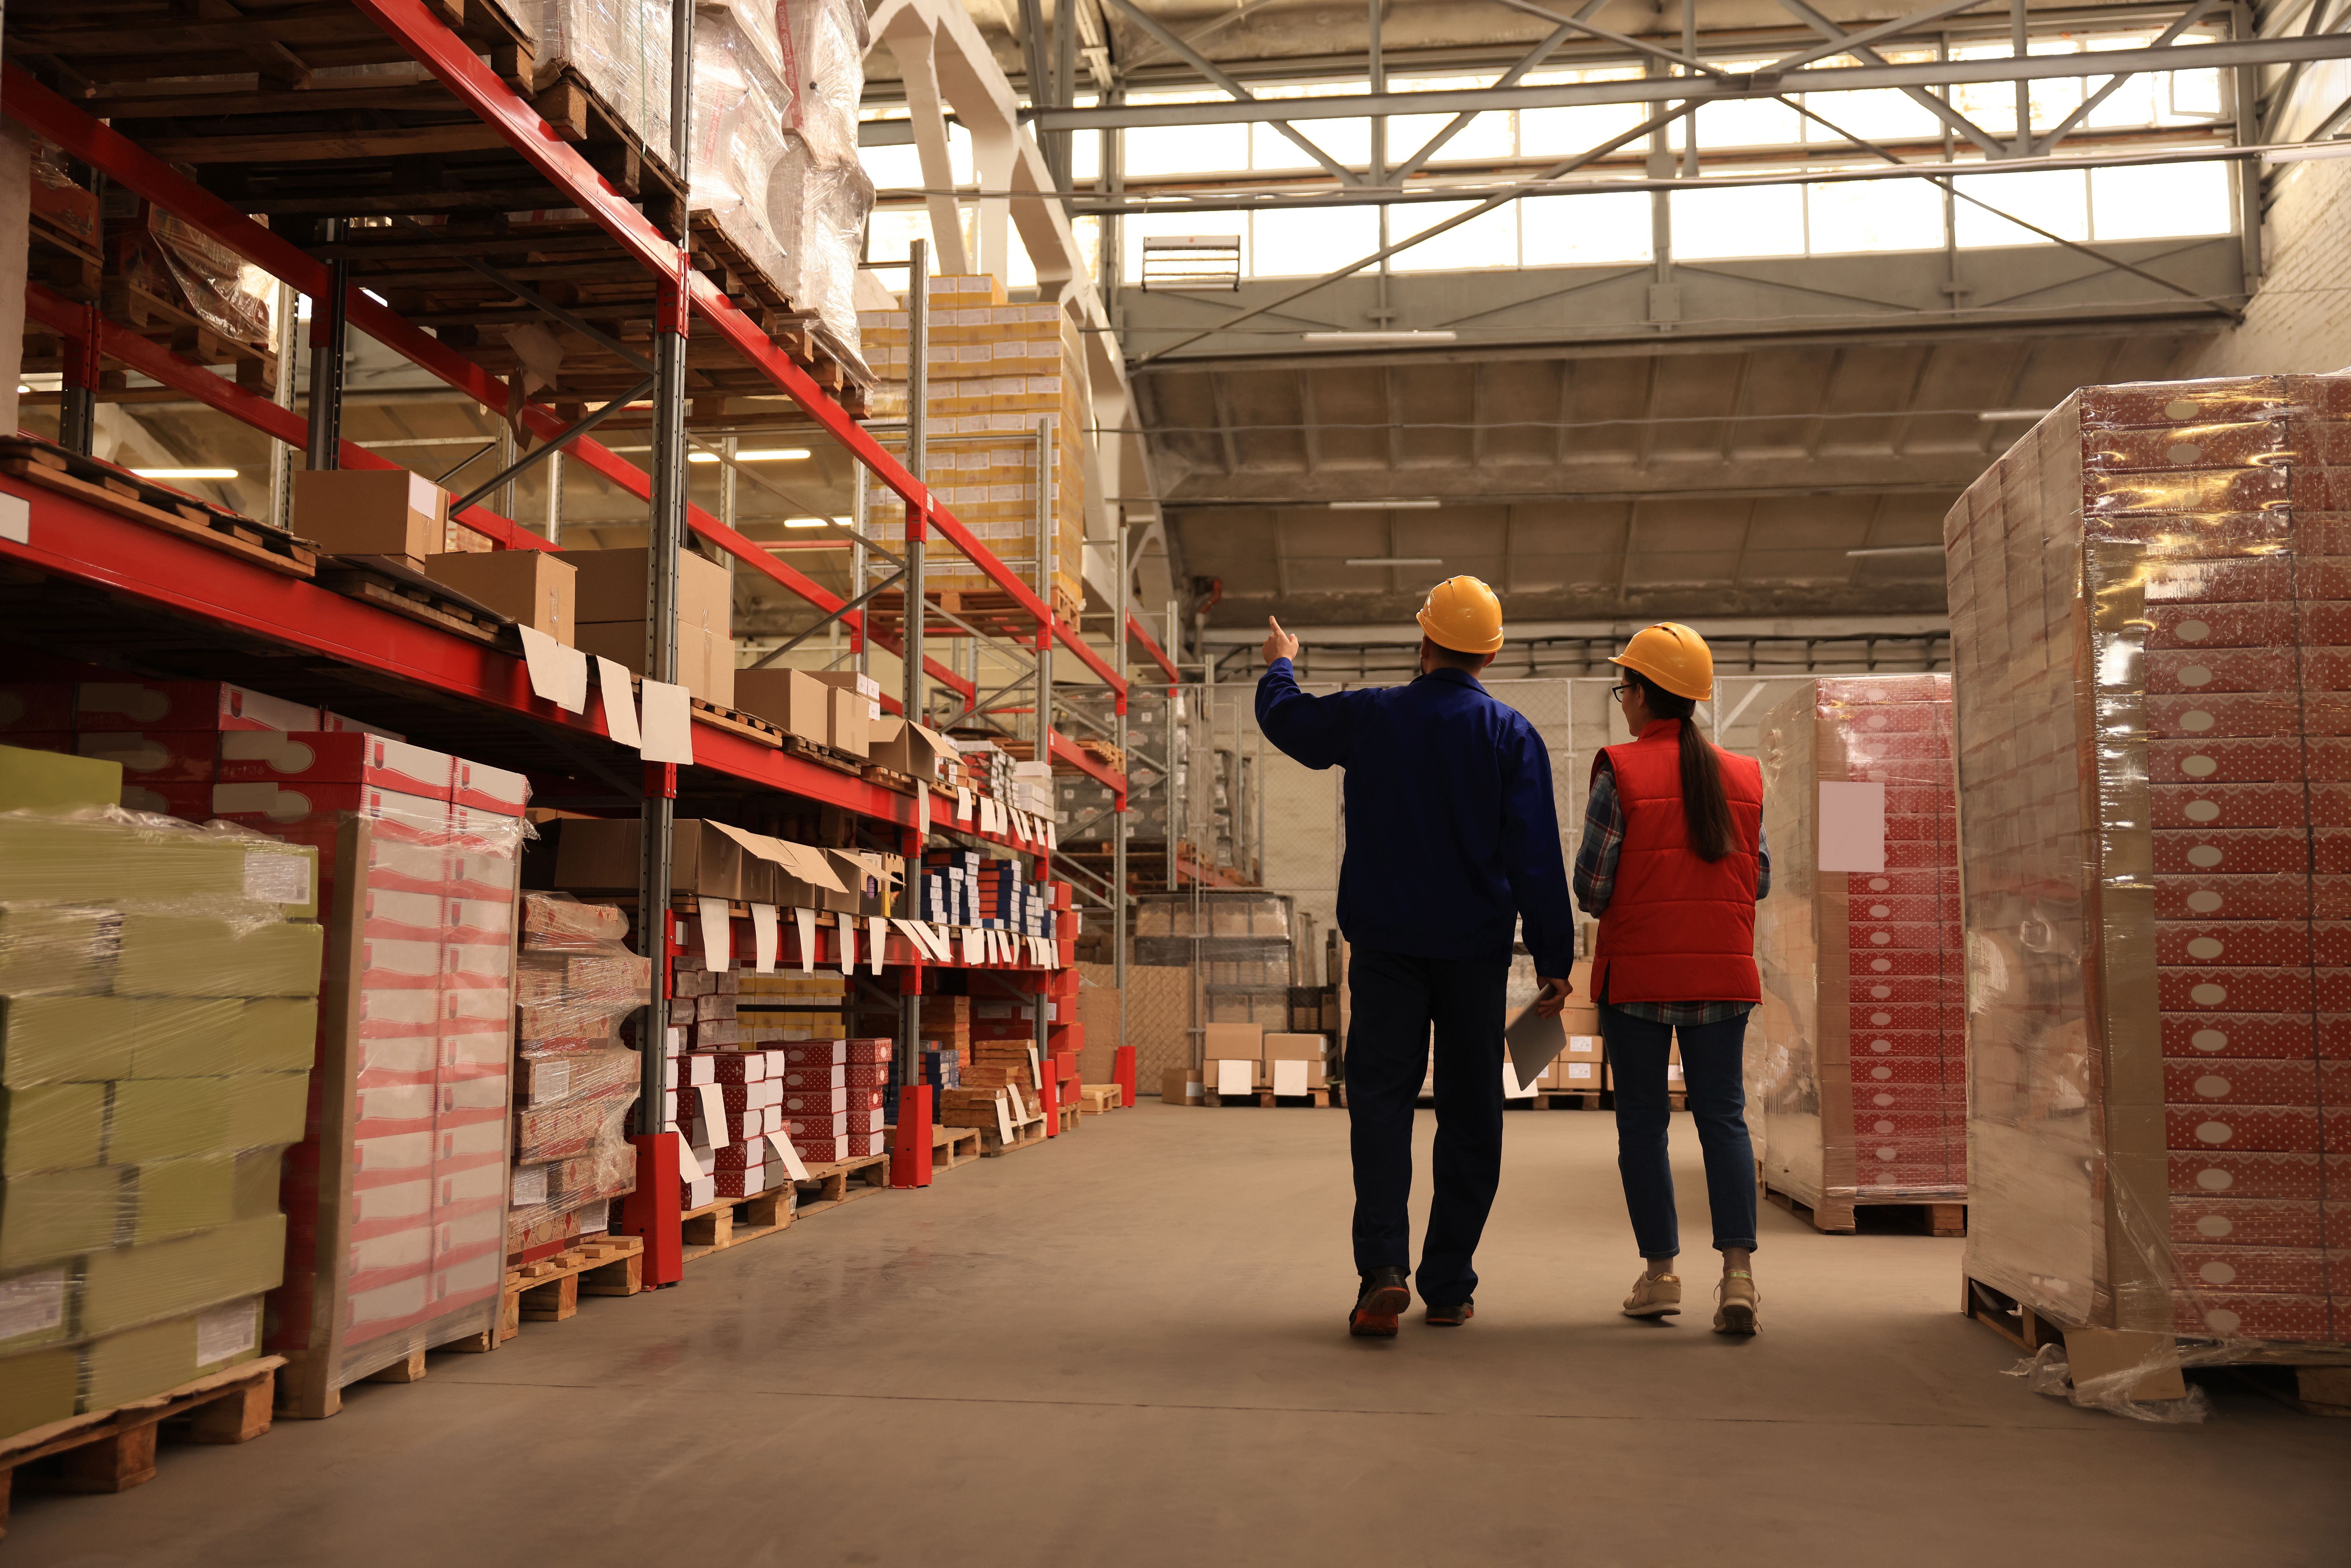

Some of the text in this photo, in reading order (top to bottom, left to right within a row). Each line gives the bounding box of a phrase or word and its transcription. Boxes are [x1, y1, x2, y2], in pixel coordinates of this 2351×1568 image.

[778, 6, 795, 89] ПЕРШЕ СЛОВО МОГО
